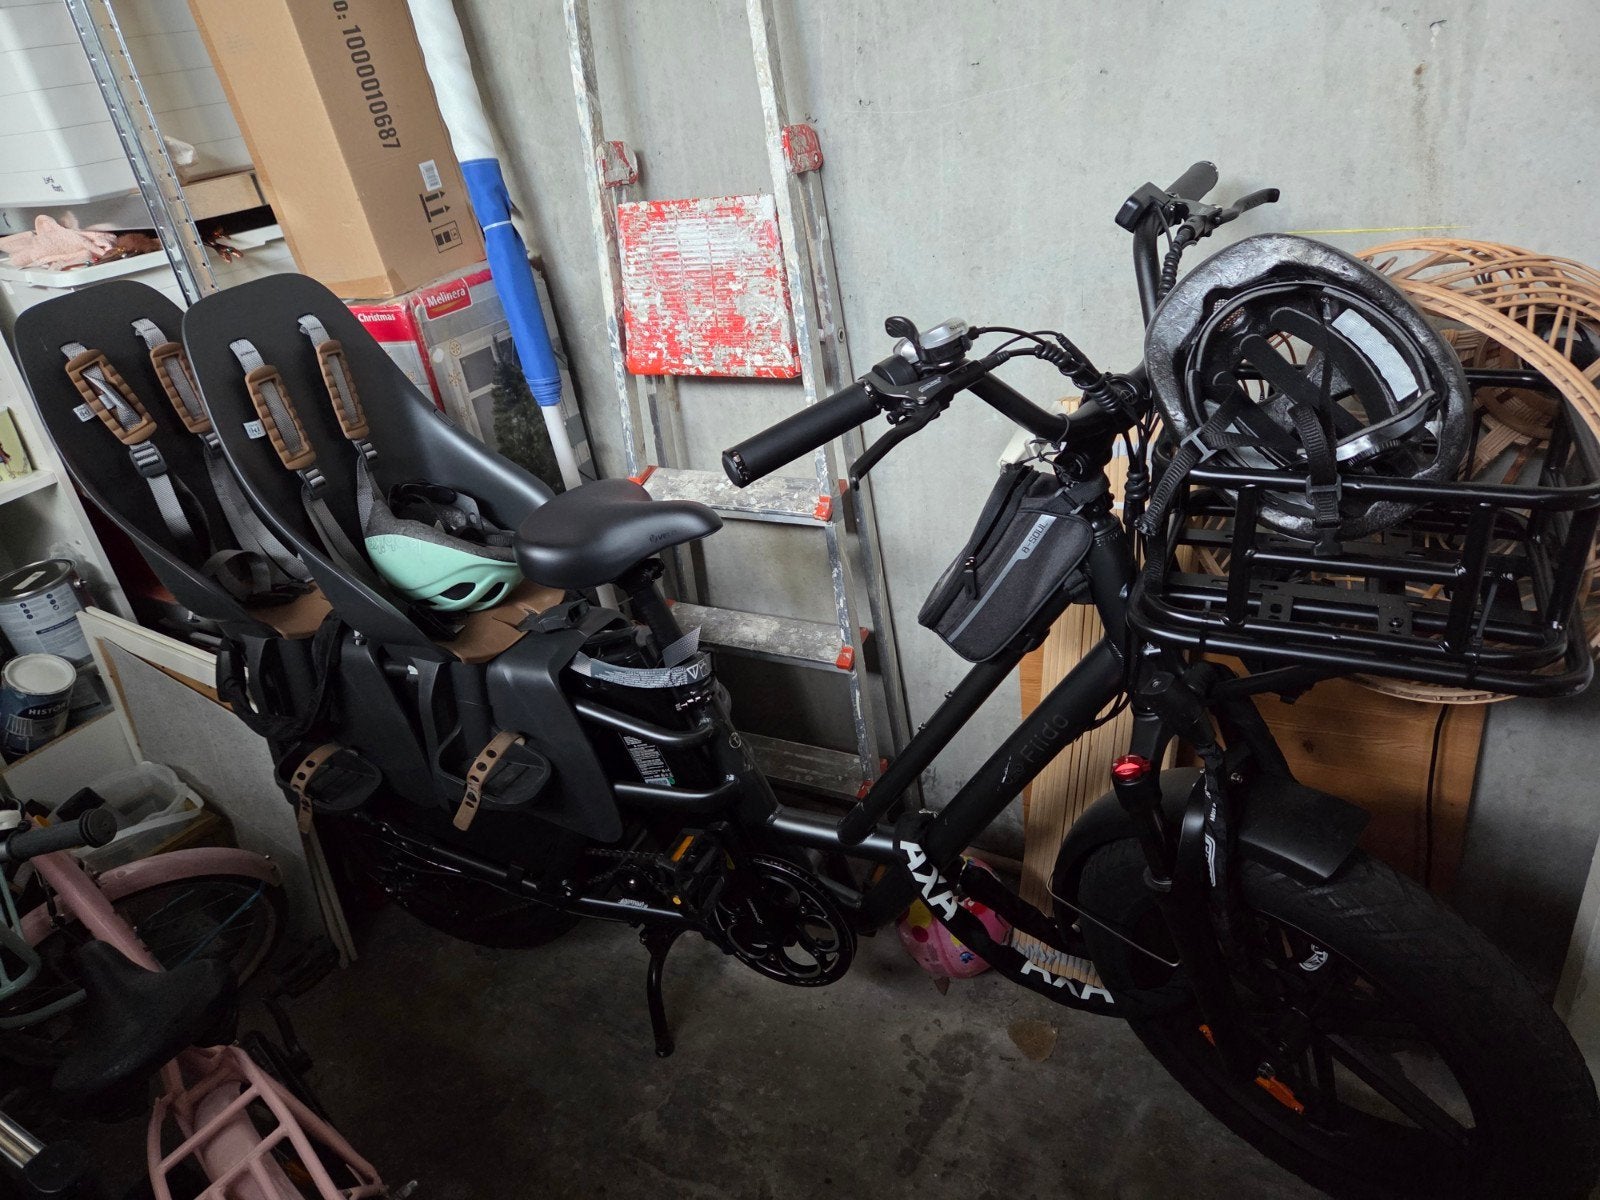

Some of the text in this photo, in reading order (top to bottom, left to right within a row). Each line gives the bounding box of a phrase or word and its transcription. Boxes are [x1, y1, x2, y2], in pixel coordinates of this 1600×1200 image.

[342, 24, 401, 148] 1000010687
[357, 313, 396, 322] Christmas
[426, 286, 466, 308] Melinera
[1020, 714, 1069, 763] Fiido
[899, 840, 958, 921] AXA
